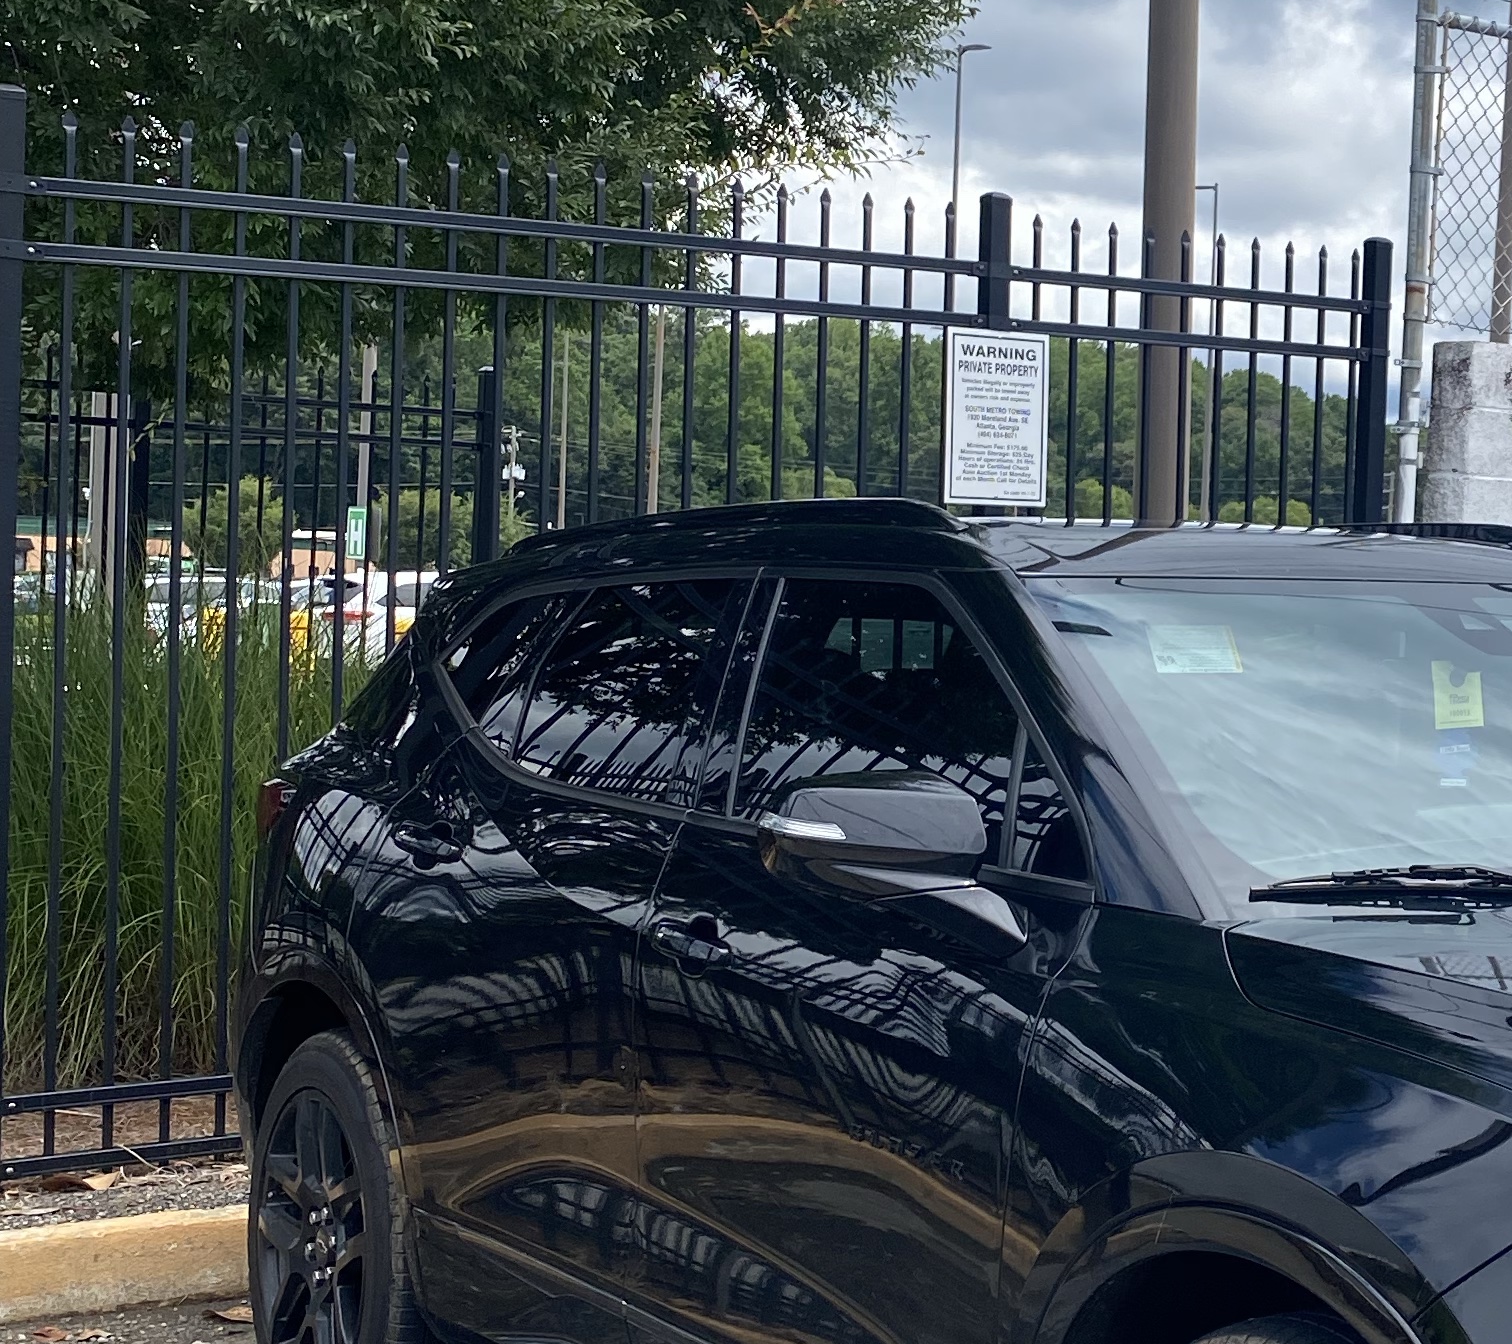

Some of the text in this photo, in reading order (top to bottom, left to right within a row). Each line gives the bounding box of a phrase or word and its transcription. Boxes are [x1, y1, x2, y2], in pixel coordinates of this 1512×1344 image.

[961, 343, 1037, 361] WARNING
[958, 359, 1039, 377] PRIVATE PROPERTY
[965, 405, 985, 413] SOUTH
[986, 406, 1007, 414] METRO
[350, 519, 363, 555] H
